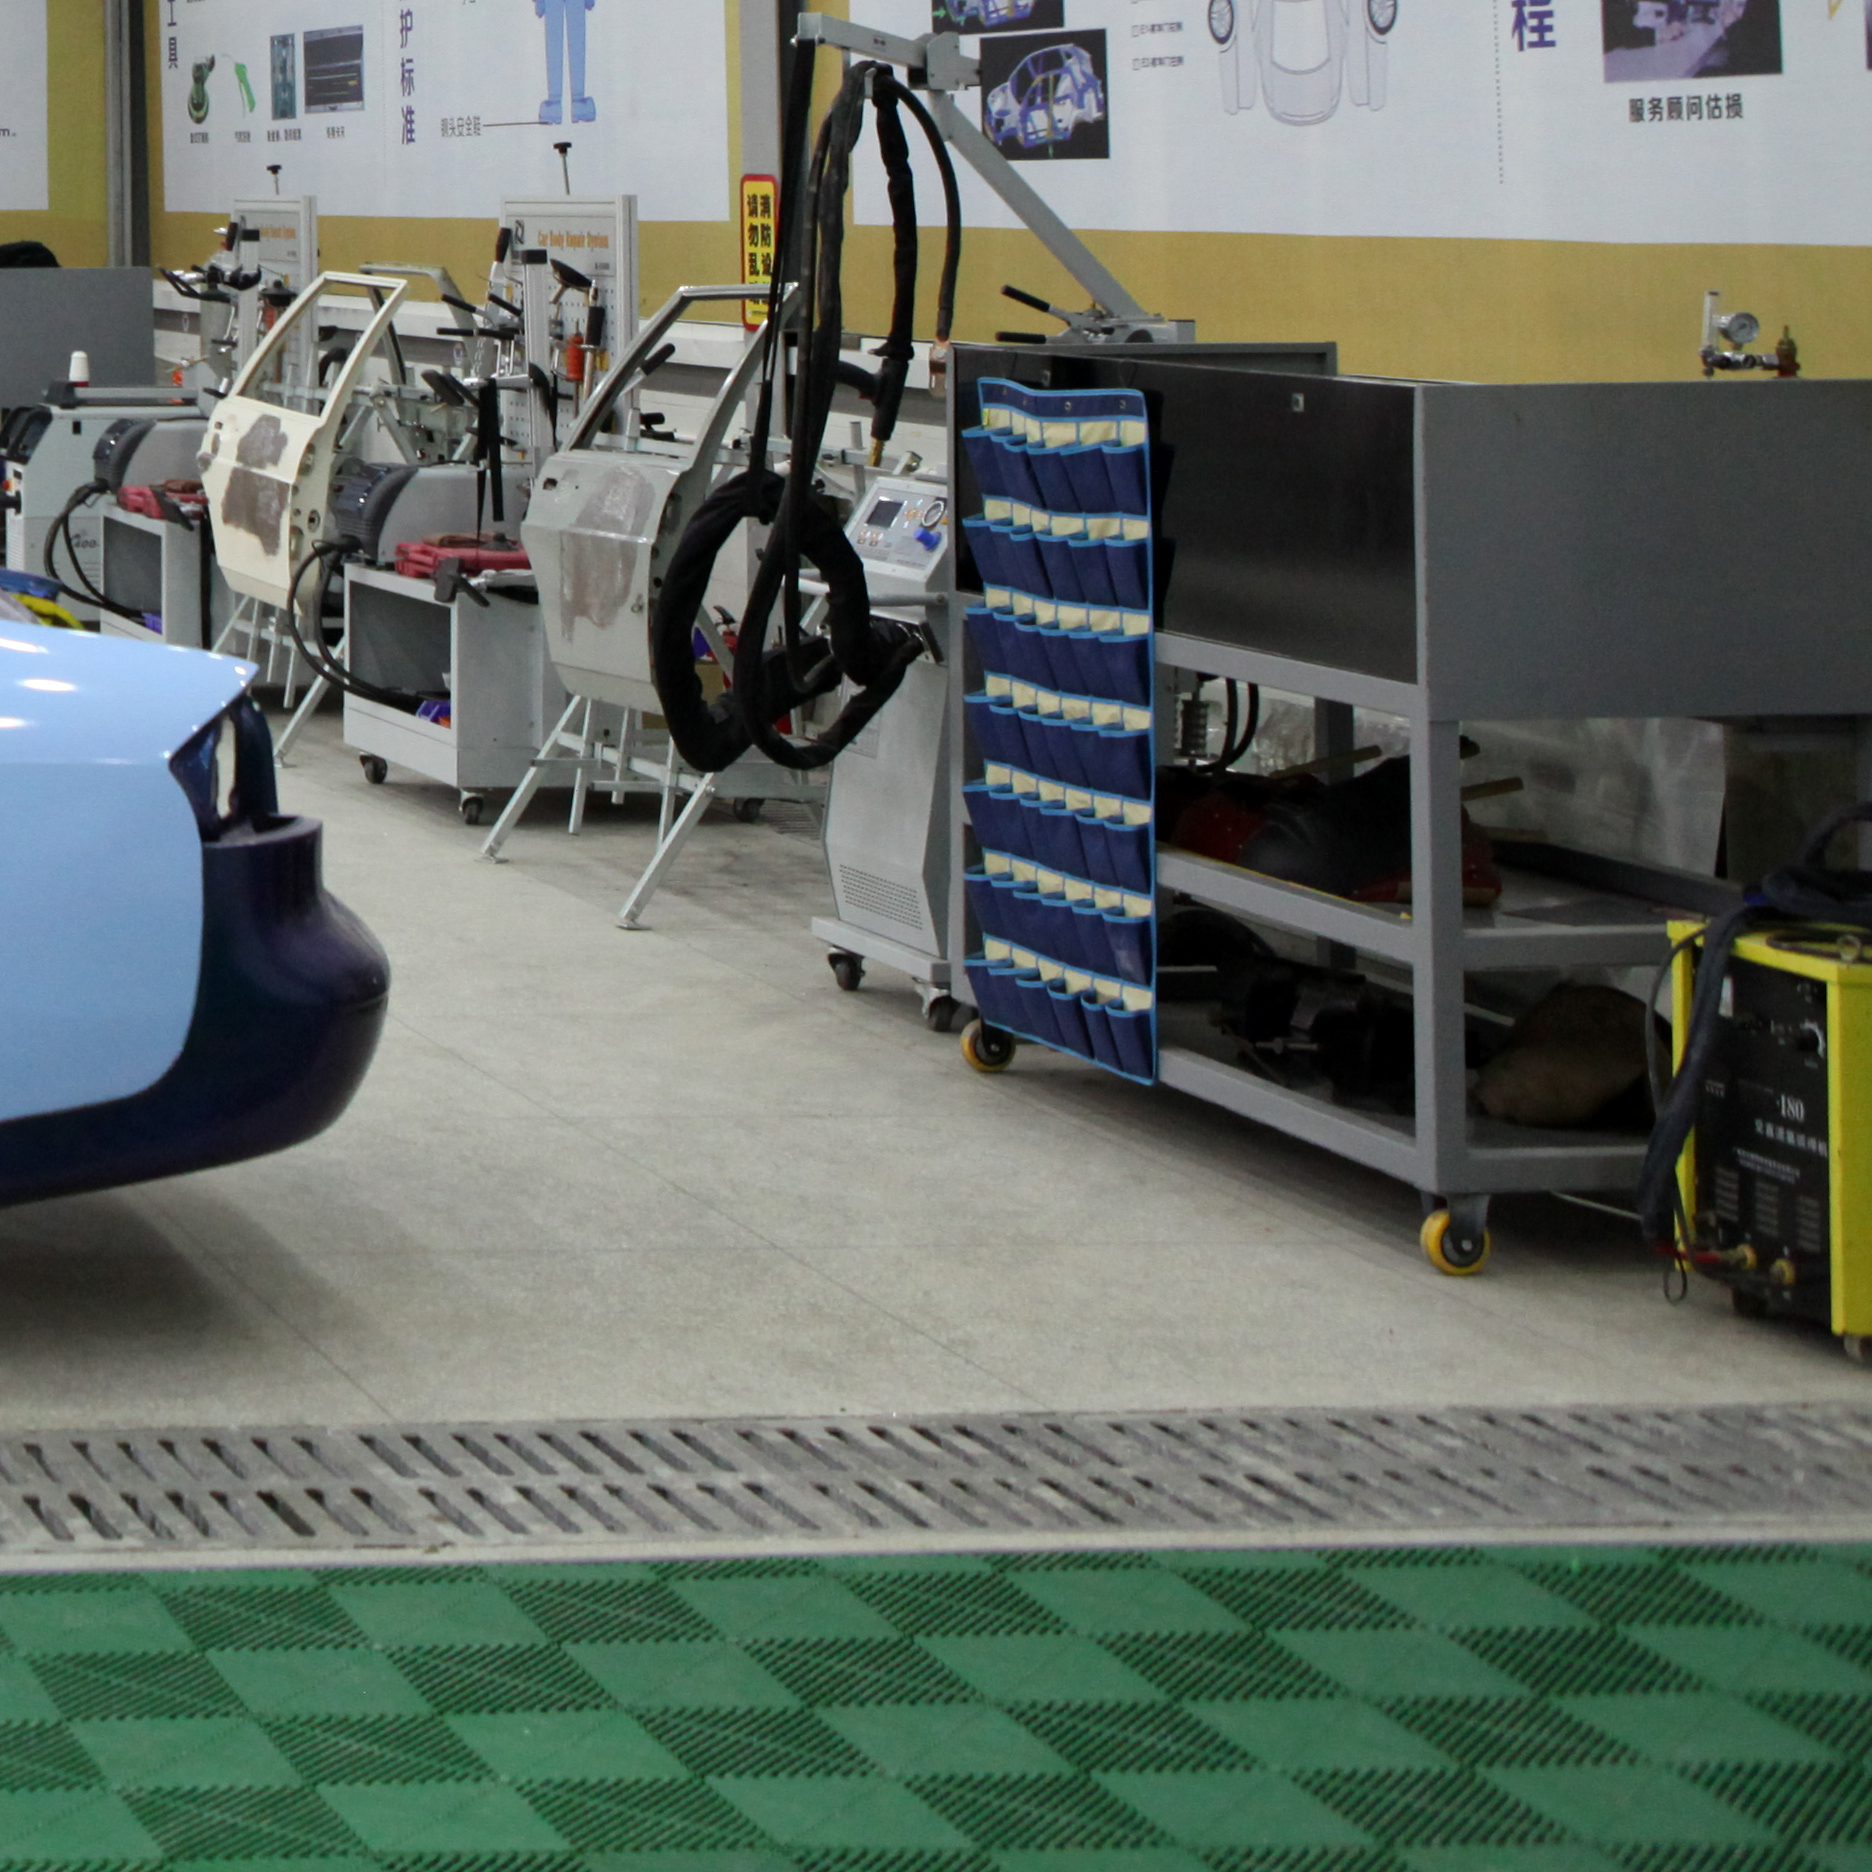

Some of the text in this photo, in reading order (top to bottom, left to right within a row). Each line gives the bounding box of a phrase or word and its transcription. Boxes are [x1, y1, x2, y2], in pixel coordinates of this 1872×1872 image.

[1629, 93, 1743, 122] 服务顾问估损
